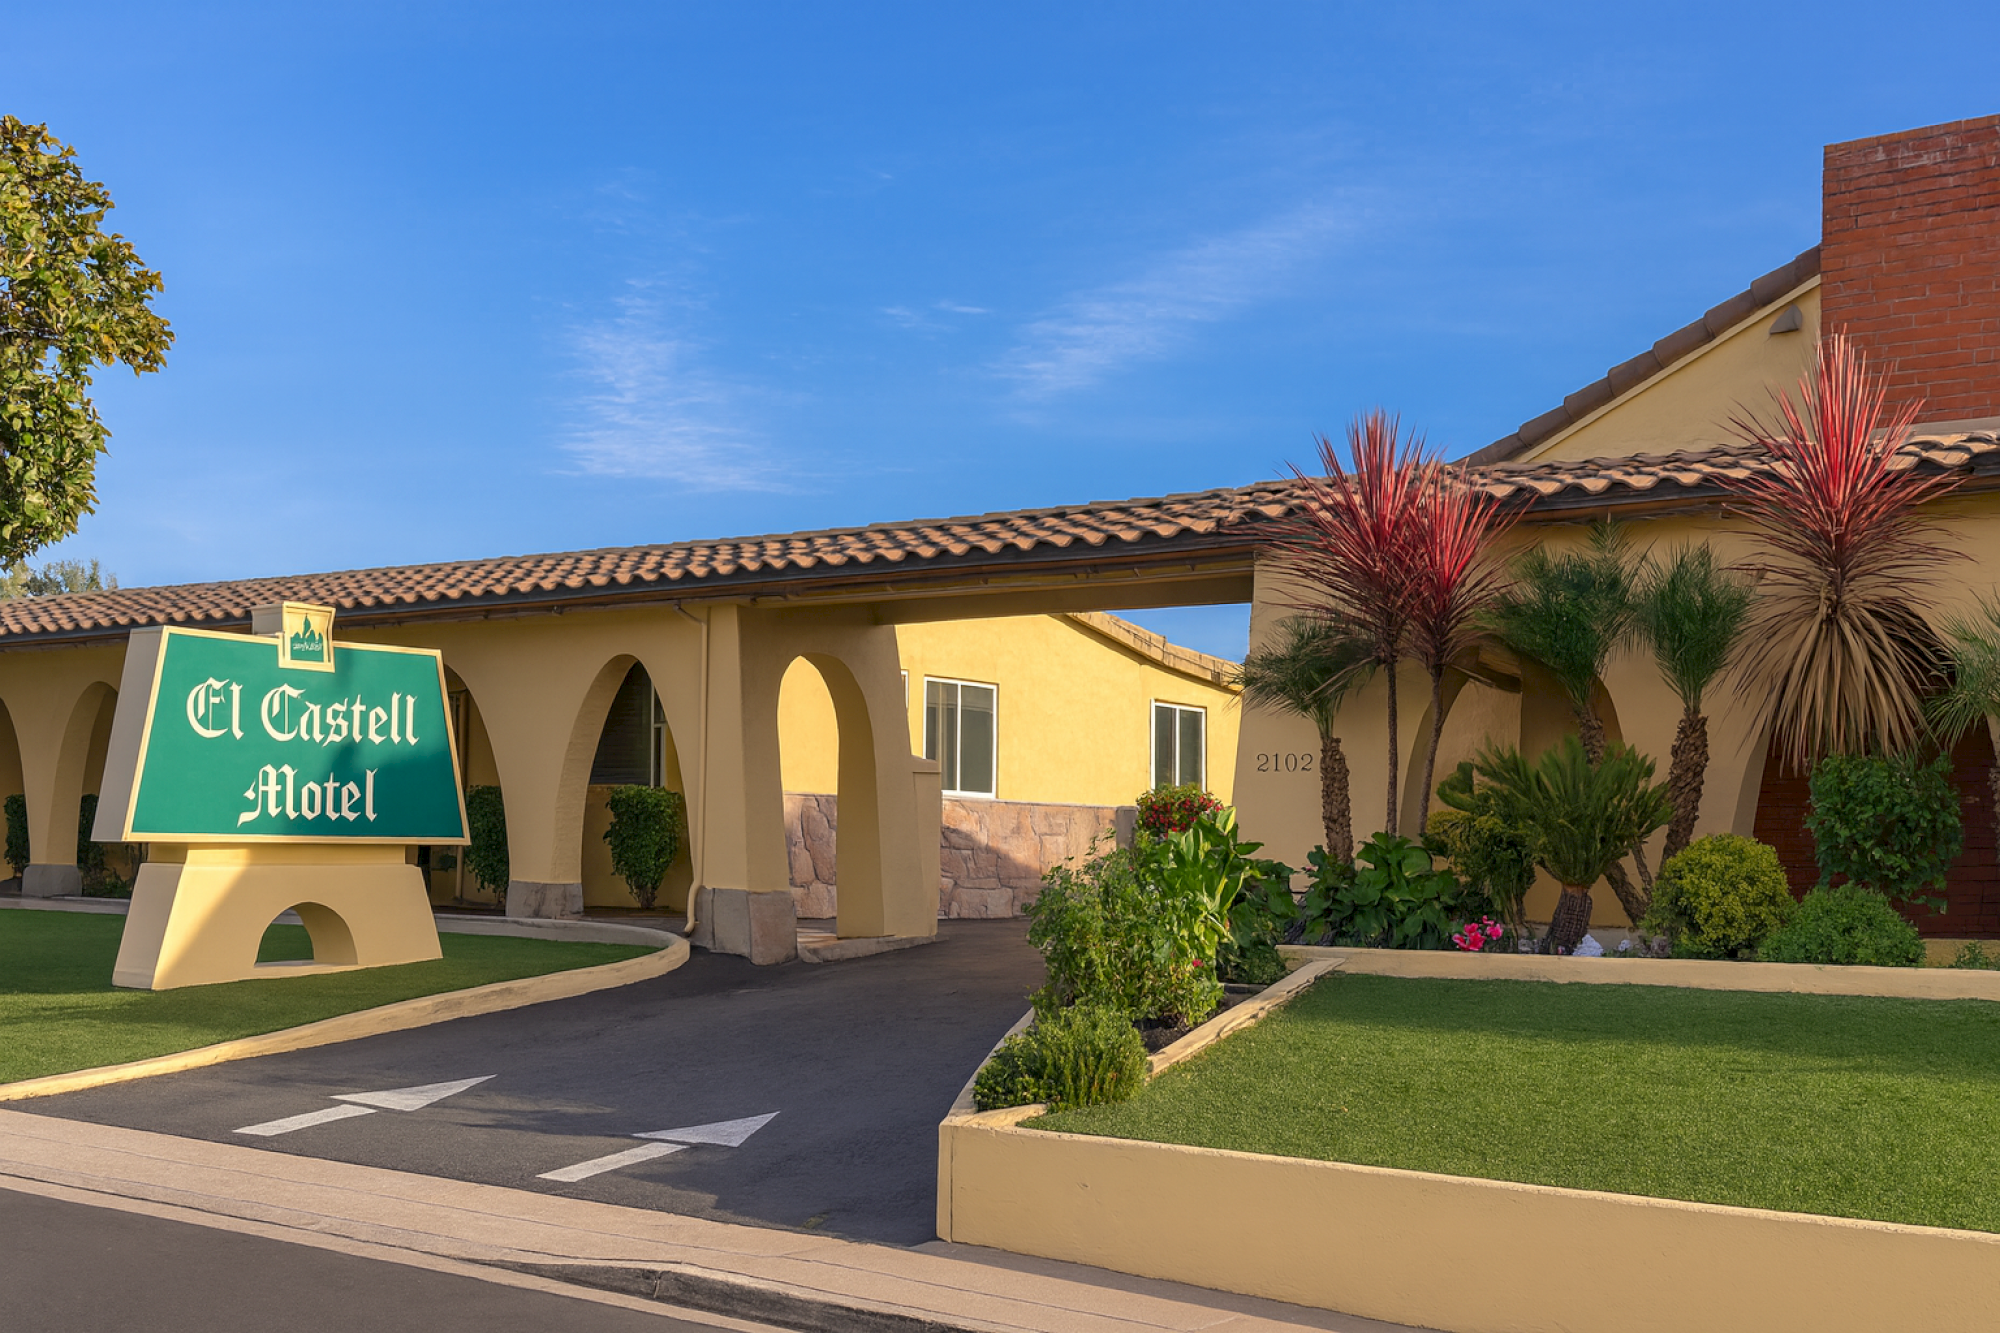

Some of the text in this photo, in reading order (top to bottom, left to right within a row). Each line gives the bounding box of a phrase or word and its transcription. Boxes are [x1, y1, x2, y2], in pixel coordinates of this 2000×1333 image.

[186, 677, 420, 747] El Castell
[1256, 752, 1314, 773] 2102
[237, 763, 378, 828] Motel
